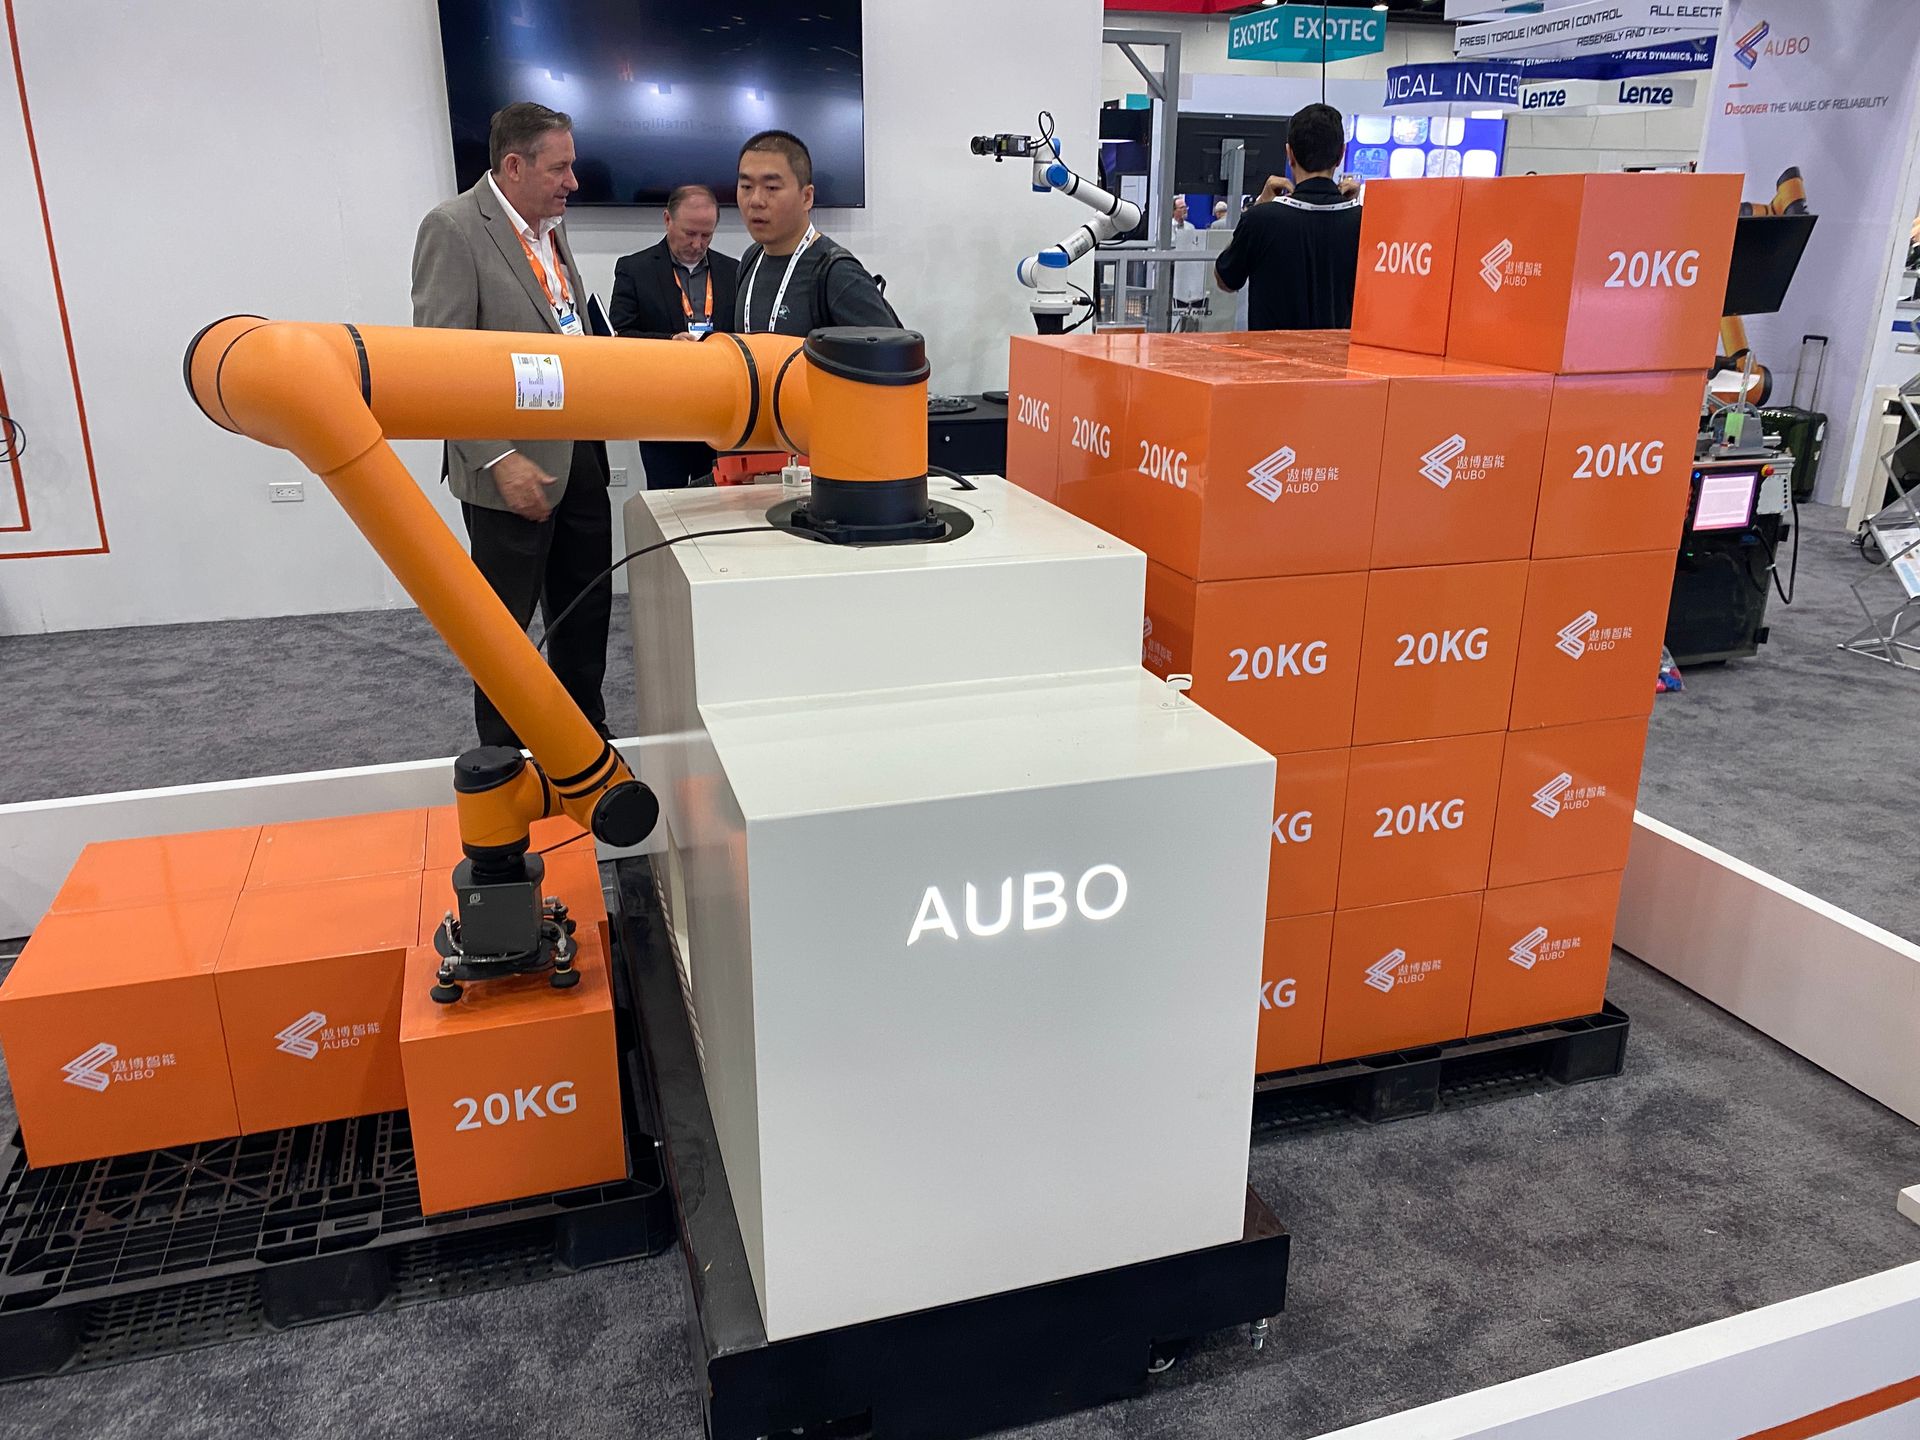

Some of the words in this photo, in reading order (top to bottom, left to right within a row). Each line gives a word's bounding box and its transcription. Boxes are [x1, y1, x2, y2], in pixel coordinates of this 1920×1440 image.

[1650, 5, 1675, 16] ALL
[1233, 18, 1279, 48] EXOTEC
[1293, 17, 1377, 42] EXOTEC
[1460, 35, 1486, 47] PRESS
[1491, 28, 1525, 42] TORQUE
[1530, 18, 1570, 36] MONITOR
[1576, 8, 1623, 27] CONTROL
[1576, 31, 1623, 47] ASSEMBLY
[1625, 27, 1646, 39] AND
[1625, 51, 1647, 60] APEX
[1649, 51, 1693, 62] DYNAMICS,
[1694, 53, 1709, 62] INC
[1763, 36, 1810, 57] AUBO
[1456, 72, 1521, 98] INTEG
[1619, 81, 1673, 105] Lenze
[1522, 89, 1566, 109] Lenze
[1770, 102, 1787, 113] THE
[1788, 101, 1817, 112] VALUE
[1817, 100, 1831, 111] OF
[1832, 96, 1889, 110] RELIABILITY
[1374, 241, 1433, 276] 20KG
[1604, 250, 1700, 288] 20KG
[1504, 275, 1527, 287] AUBO
[1017, 394, 1050, 433] 20KG
[1071, 415, 1111, 459] 20KG
[1138, 439, 1188, 489] 20KG
[1572, 440, 1664, 479] 20KG
[1286, 482, 1319, 493] AUBO
[1455, 470, 1486, 481] AUBO
[1394, 627, 1489, 667] 20KG
[1587, 641, 1615, 652] AUBO
[1227, 640, 1328, 682] 20KG
[1562, 799, 1590, 810] AUBO
[1373, 798, 1465, 838] 20KG
[906, 863, 1128, 947] AUBO
[1539, 951, 1565, 962] AUBO
[1397, 973, 1425, 984] AUBO
[323, 1037, 360, 1050] AUBO
[114, 1068, 155, 1083] AUBO
[453, 1081, 577, 1131] 20KG
